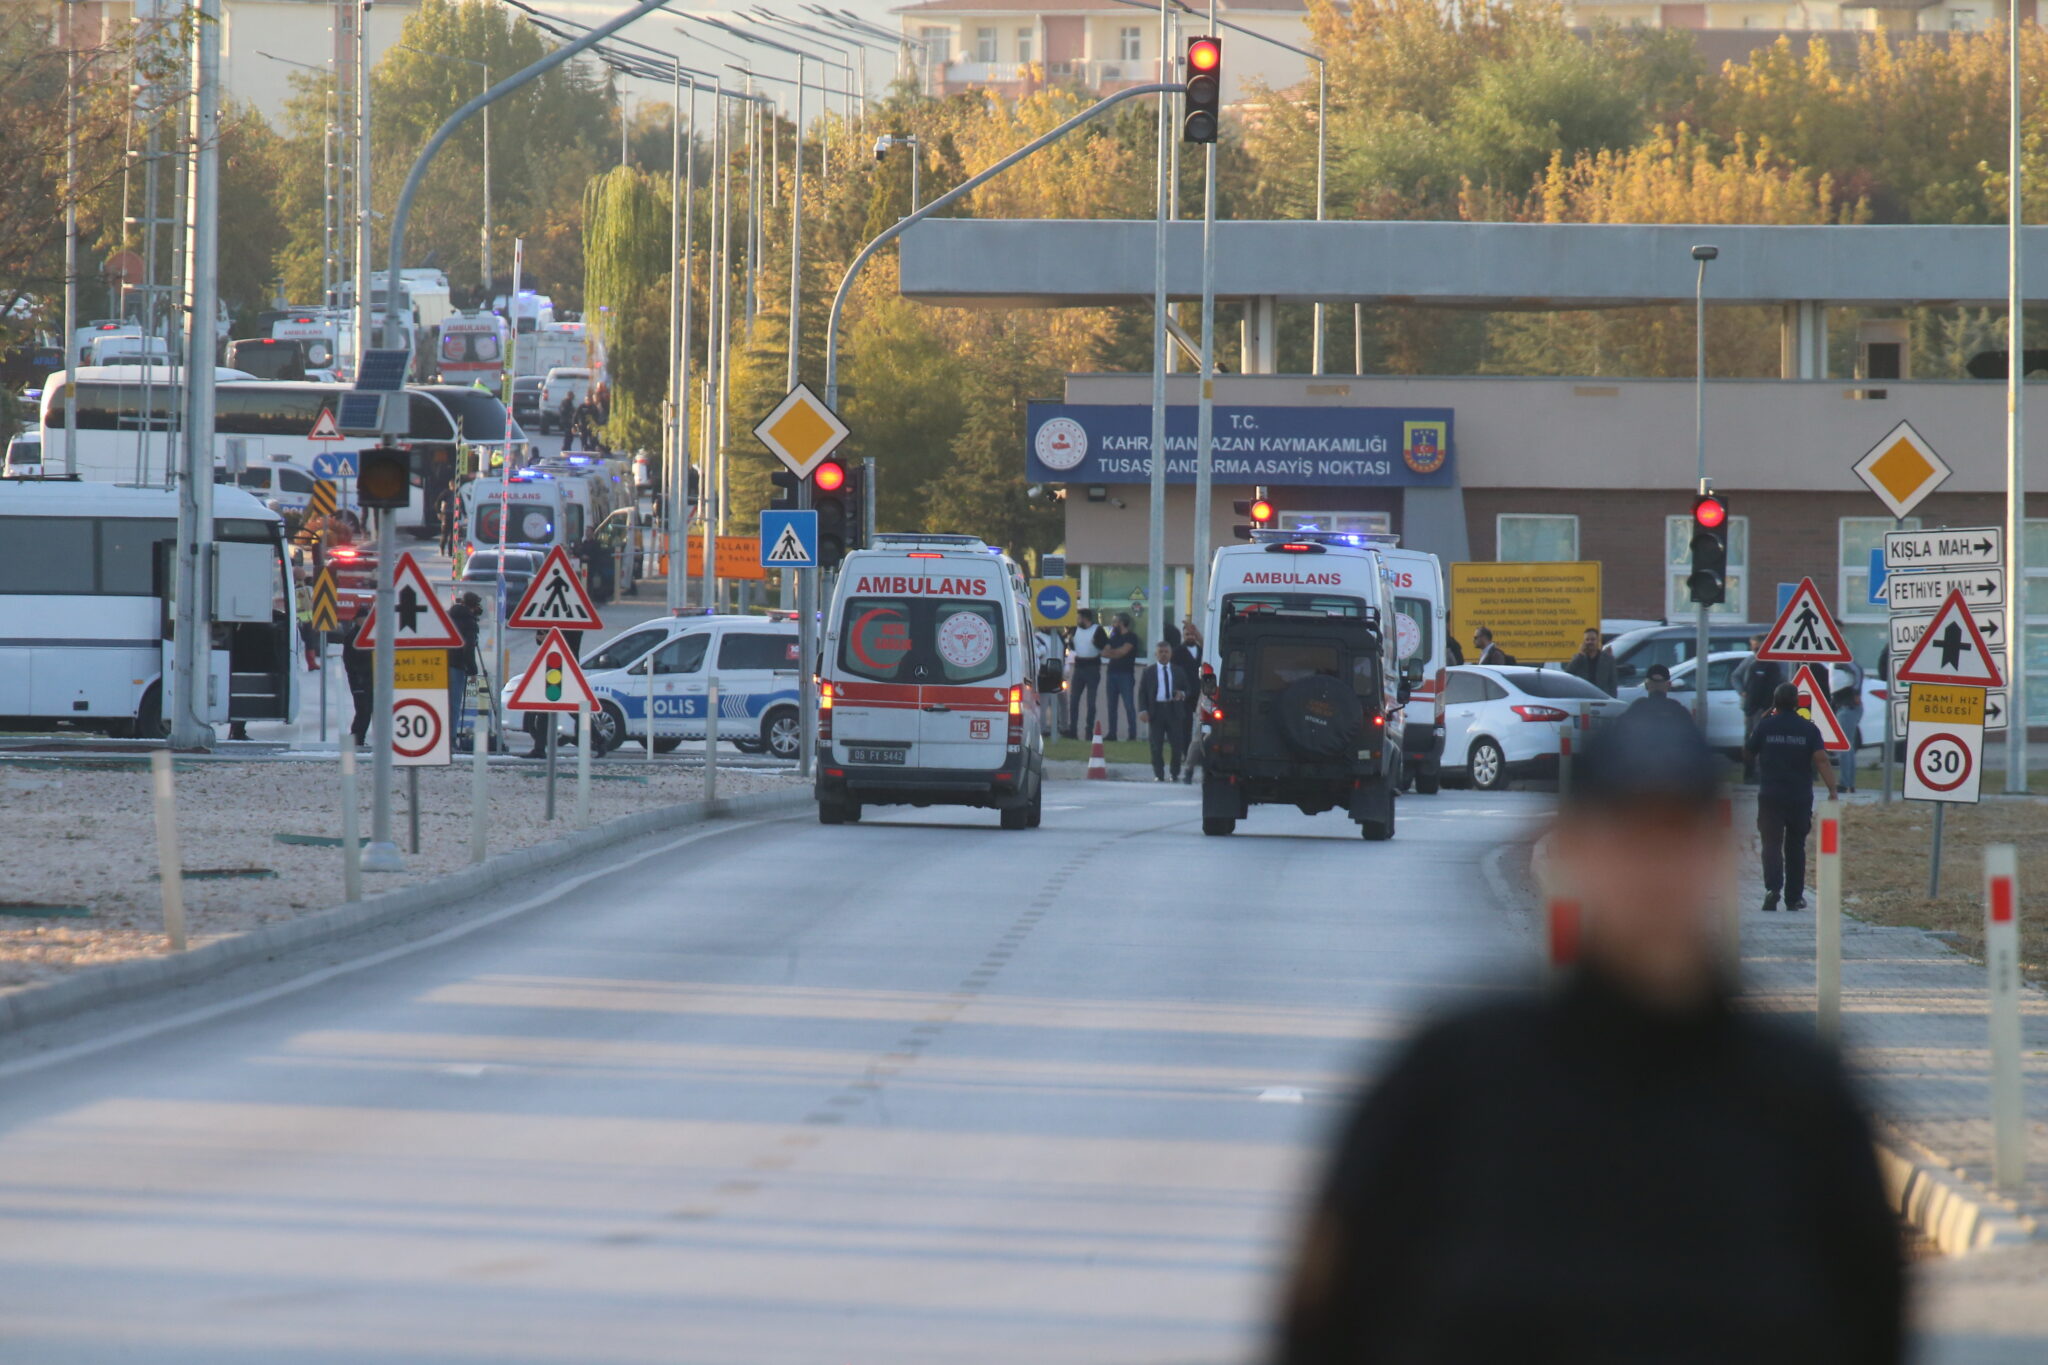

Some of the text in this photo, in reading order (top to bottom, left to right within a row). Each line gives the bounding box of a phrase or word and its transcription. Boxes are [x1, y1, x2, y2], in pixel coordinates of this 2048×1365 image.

[1230, 415, 1259, 429] T.C.
[1260, 435, 1387, 452] KAYMAKAMLIĞI
[1098, 458, 1152, 476] TUSAŞ
[1254, 457, 1313, 477] ASAYİŞ
[1318, 461, 1390, 474] NOKTASI
[1890, 539, 1973, 561] KIŞLA MAH.
[856, 576, 987, 596] AMBULANS
[1242, 572, 1342, 585] AMBULANS
[395, 657, 416, 666] AMİ
[395, 672, 433, 682] ÖLGESİ
[398, 715, 428, 738] 30
[973, 722, 988, 732] 112
[1927, 749, 1960, 774] 30
